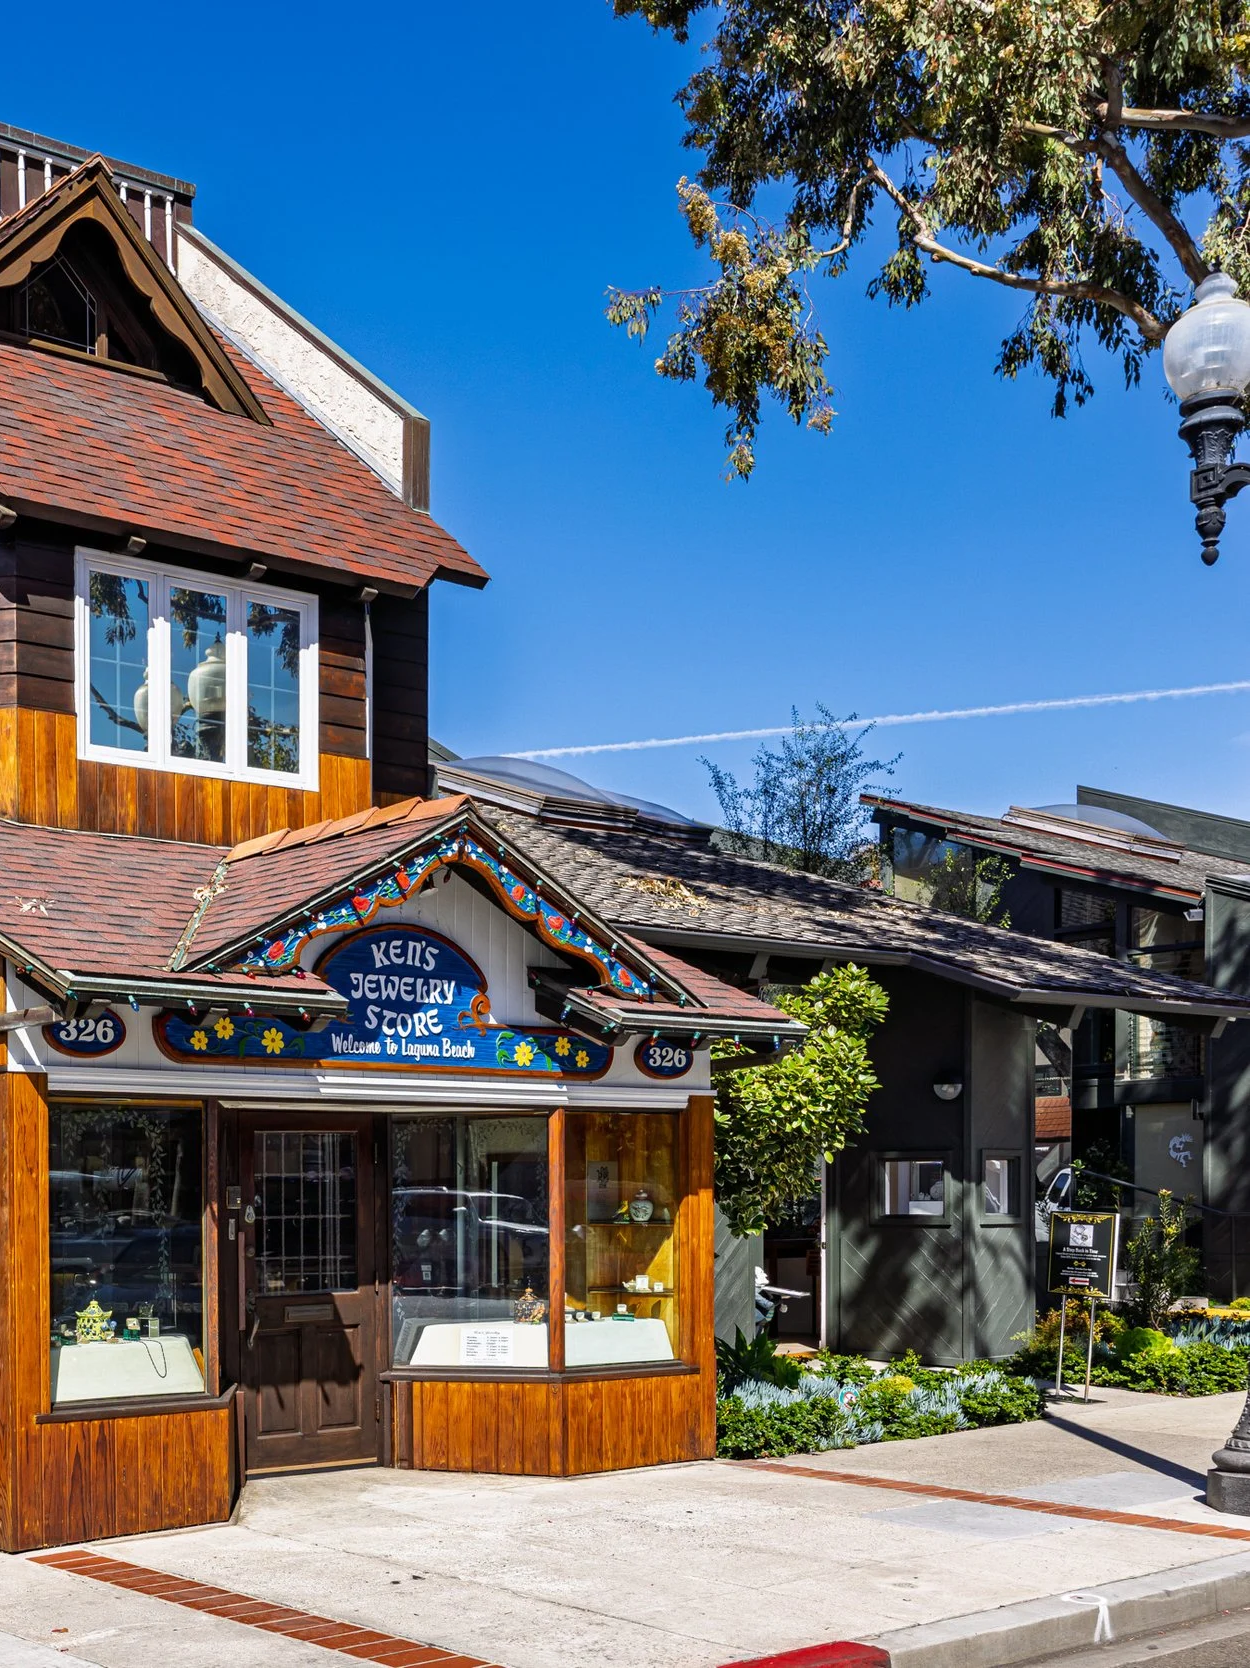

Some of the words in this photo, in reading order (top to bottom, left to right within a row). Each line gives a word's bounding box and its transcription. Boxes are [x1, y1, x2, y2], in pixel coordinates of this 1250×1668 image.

[350, 972, 456, 1005] JEWELRY
[59, 1018, 115, 1044] 326
[364, 1004, 443, 1038] STORE
[331, 1032, 382, 1055] Welcome
[386, 1036, 398, 1055] to
[402, 1038, 440, 1062] Laguna
[442, 1038, 476, 1058] Beach
[648, 1046, 686, 1068] 326
